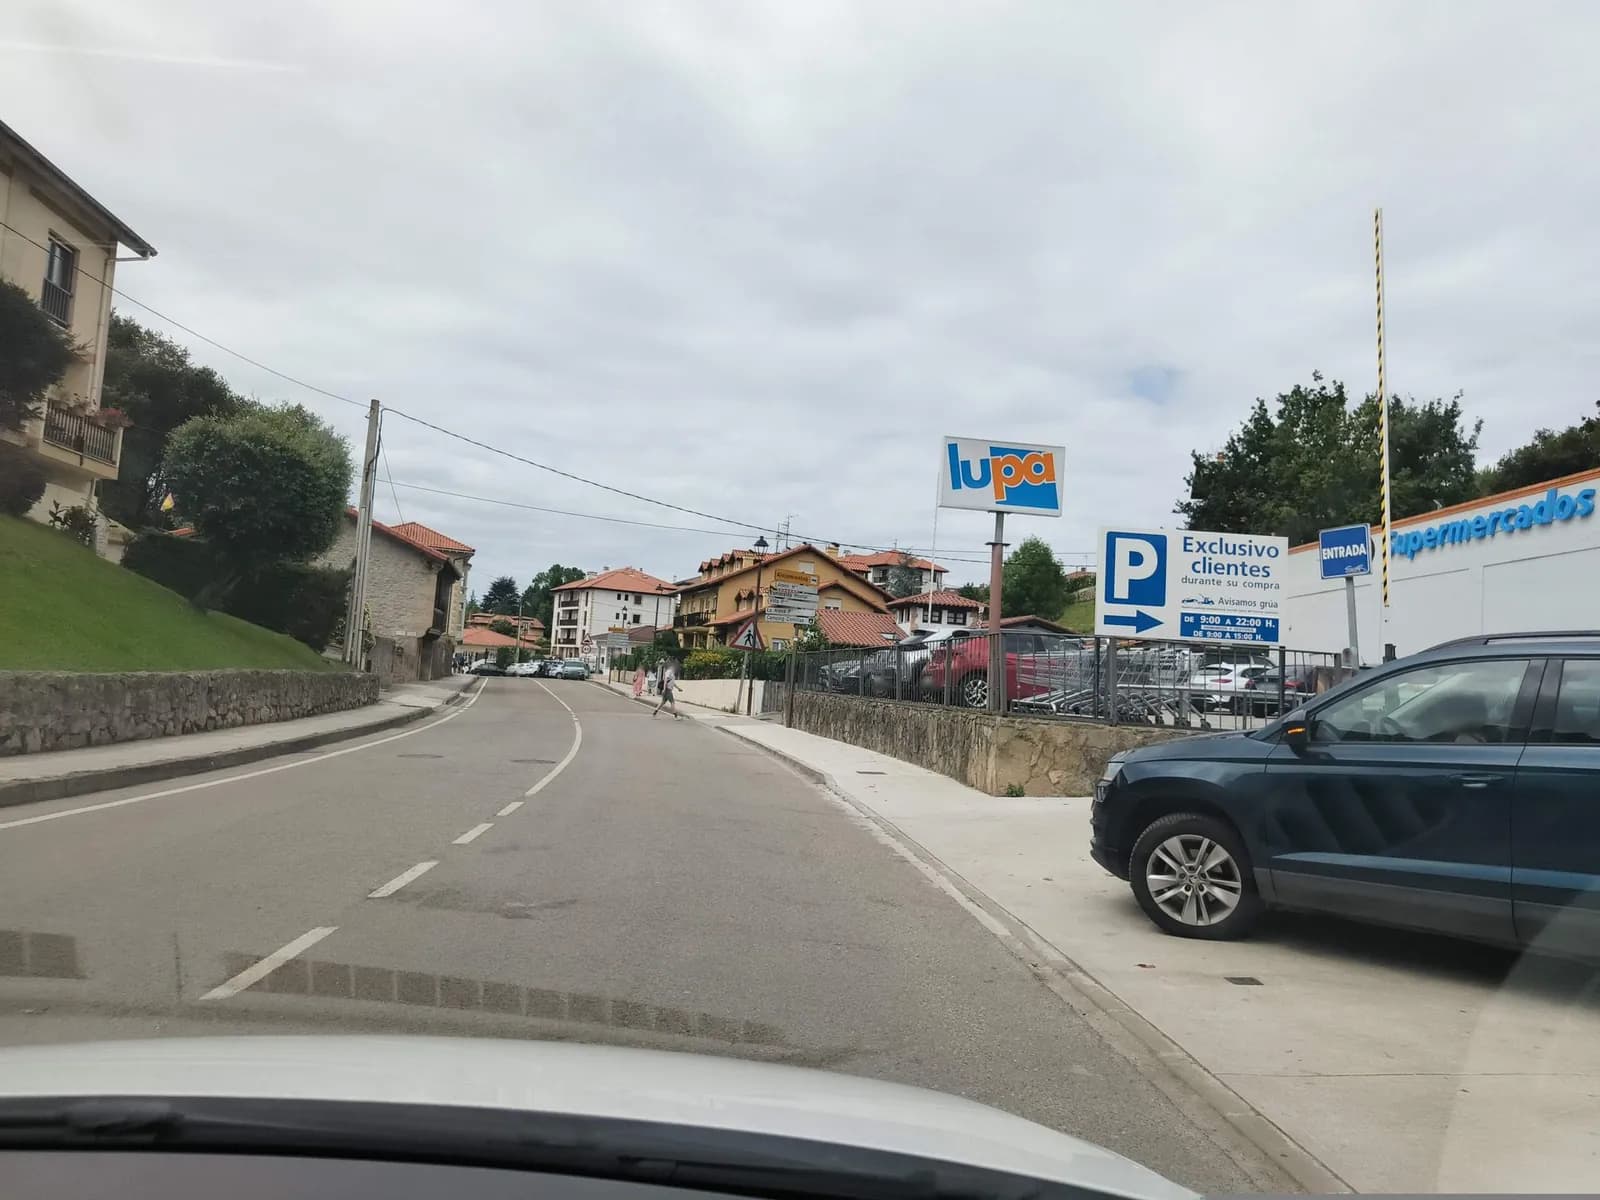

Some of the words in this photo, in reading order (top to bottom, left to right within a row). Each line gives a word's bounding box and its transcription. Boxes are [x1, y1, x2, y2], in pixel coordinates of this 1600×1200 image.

[948, 443, 1056, 500] lupa
[1183, 536, 1279, 558] Exclusivo
[1322, 543, 1367, 560] ENTRADA
[1113, 537, 1158, 599] P
[1191, 557, 1271, 578] clientes
[1181, 575, 1222, 587] durante
[1226, 579, 1238, 588] su
[1243, 580, 1280, 591] compra
[1218, 596, 1257, 608] Avisamos
[1184, 615, 1194, 623] DE
[1200, 615, 1221, 625] 9:00
[1236, 617, 1261, 627] 22:00
[1206, 630, 1222, 639] 9:00
[1225, 631, 1231, 639] A
[1234, 632, 1253, 640] 15:00
